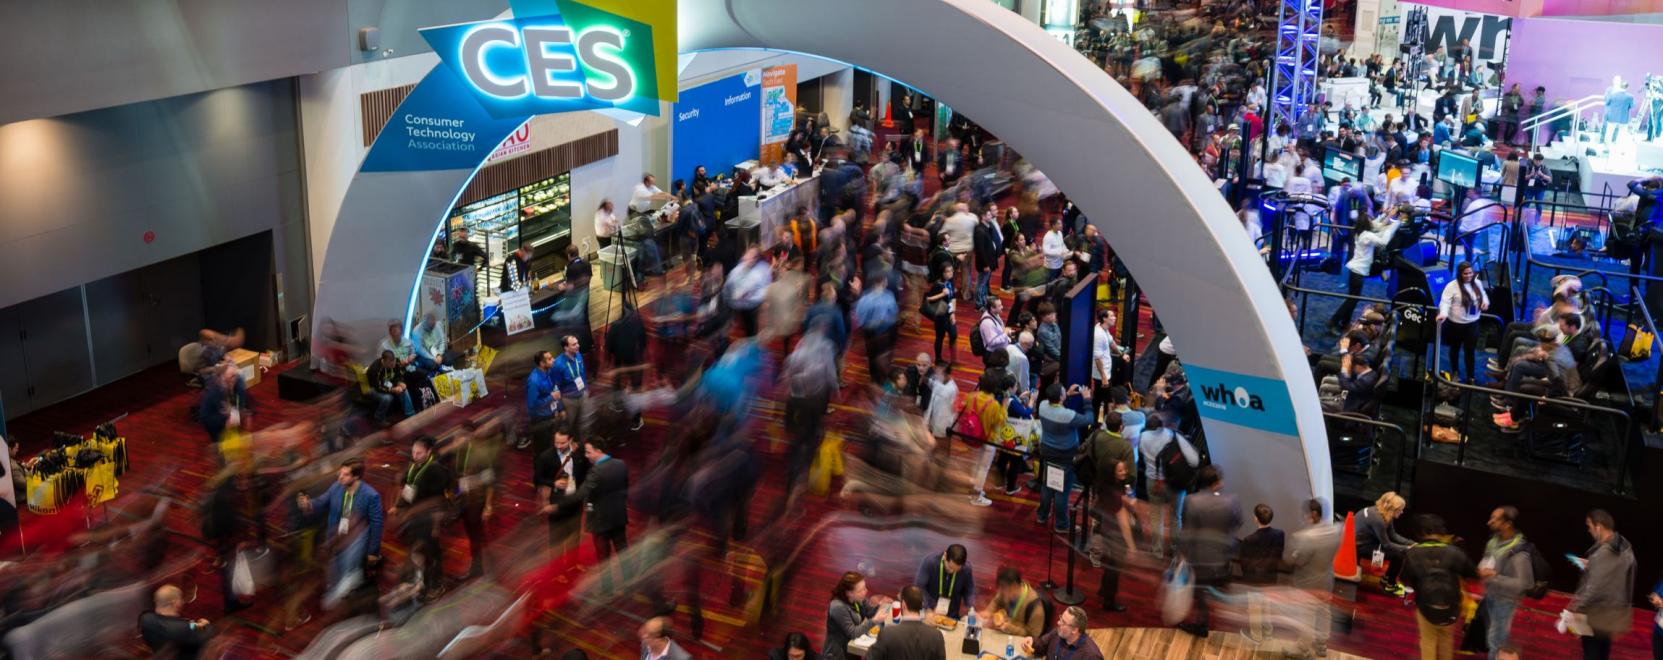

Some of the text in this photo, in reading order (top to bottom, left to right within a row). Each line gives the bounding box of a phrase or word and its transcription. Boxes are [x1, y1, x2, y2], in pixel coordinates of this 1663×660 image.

[725, 92, 752, 106] Information
[404, 113, 465, 128] Consumer
[679, 108, 699, 122] Security
[406, 126, 476, 142] Technology
[407, 139, 476, 151] Association
[508, 143, 530, 154] KITCHEN
[1201, 382, 1265, 412] whoa
